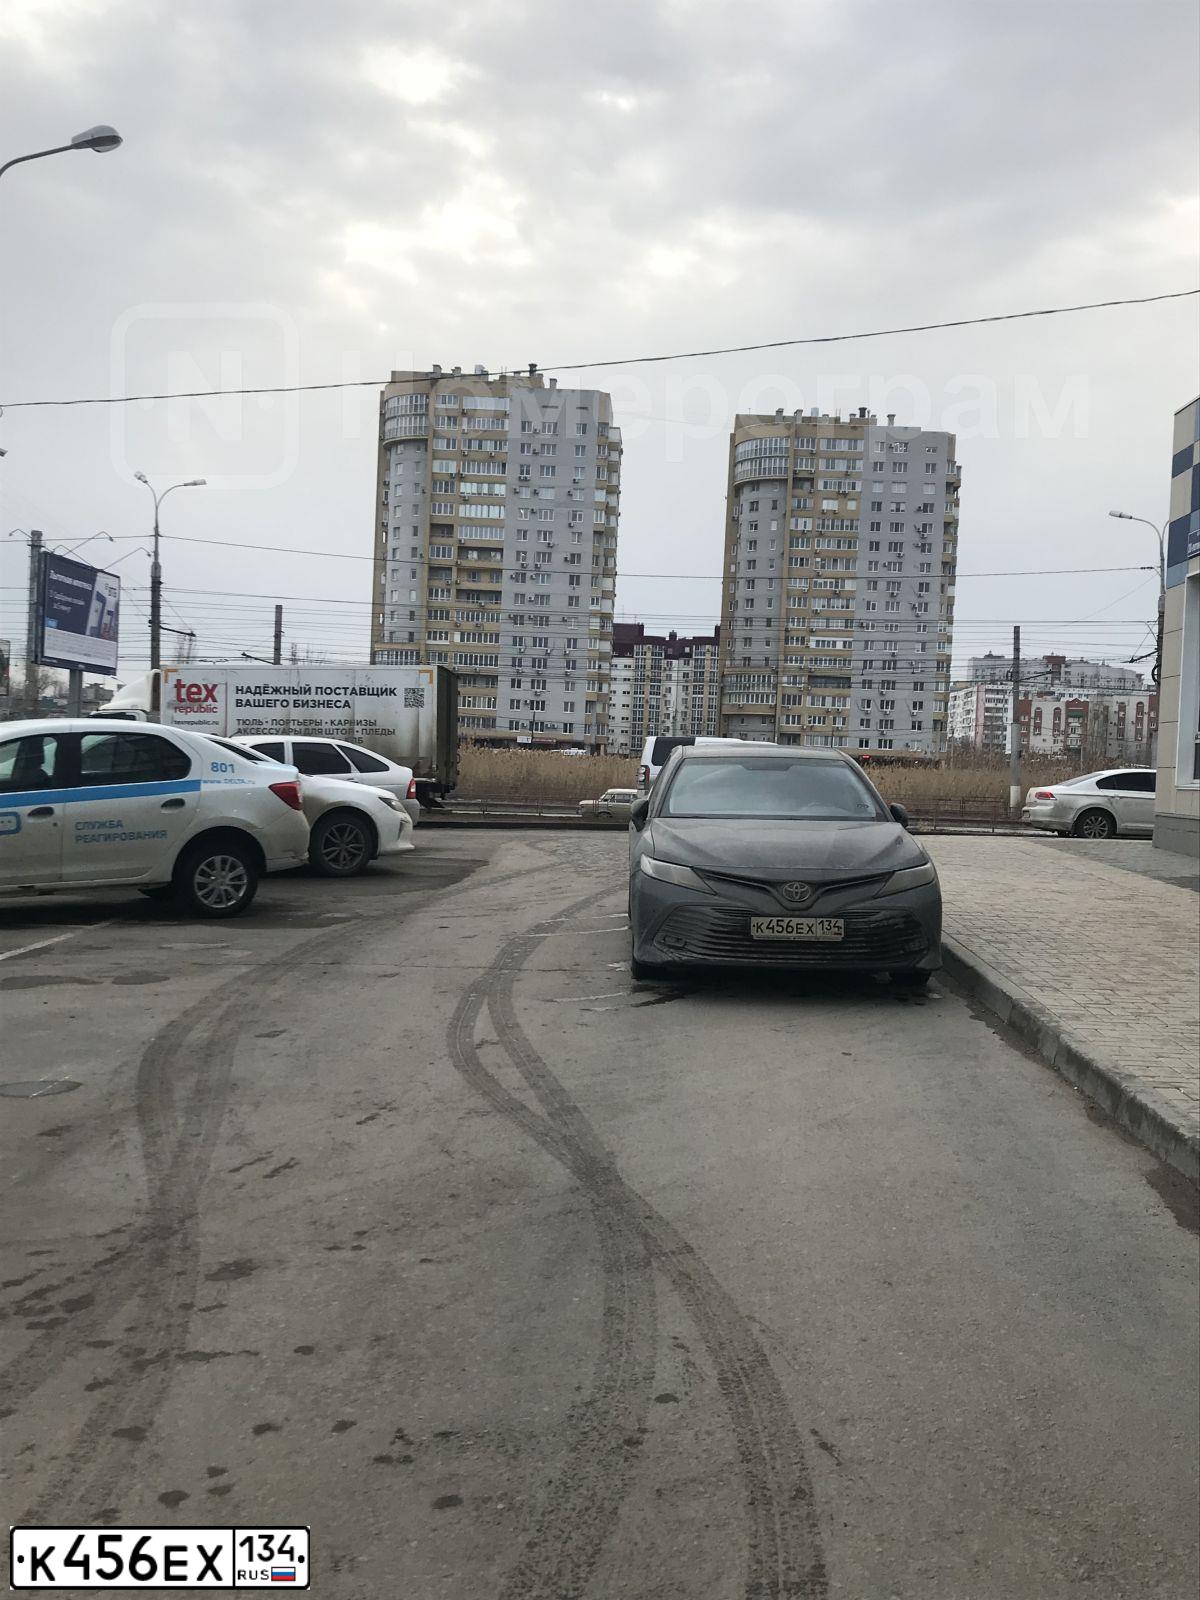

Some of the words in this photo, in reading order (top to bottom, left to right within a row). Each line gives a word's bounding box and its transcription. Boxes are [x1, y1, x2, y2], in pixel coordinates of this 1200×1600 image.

[174, 679, 218, 703] tex
[235, 683, 312, 696] НАДЁЖНЫЙ
[315, 686, 398, 697] ПОСТАВЩИК
[174, 704, 218, 715] republic
[235, 698, 290, 708] ВАШЕГО
[293, 699, 351, 709] БИЗНЕСА
[235, 718, 264, 726] ТЮЛЬ
[271, 719, 322, 727] ПОРТЬЕРЫ
[330, 719, 377, 727] КАРНИЗЫ
[237, 727, 302, 735] АКСЕССУАРЫ
[303, 728, 324, 736] ДЛЯ
[325, 728, 354, 736] ШТОР
[361, 728, 396, 737] ПЛЕДЫ
[210, 761, 235, 774] 801
[75, 820, 124, 831] СЛУЖБА
[75, 830, 168, 843] РЕАГИРОВАНИЯ
[818, 919, 842, 932] 134
